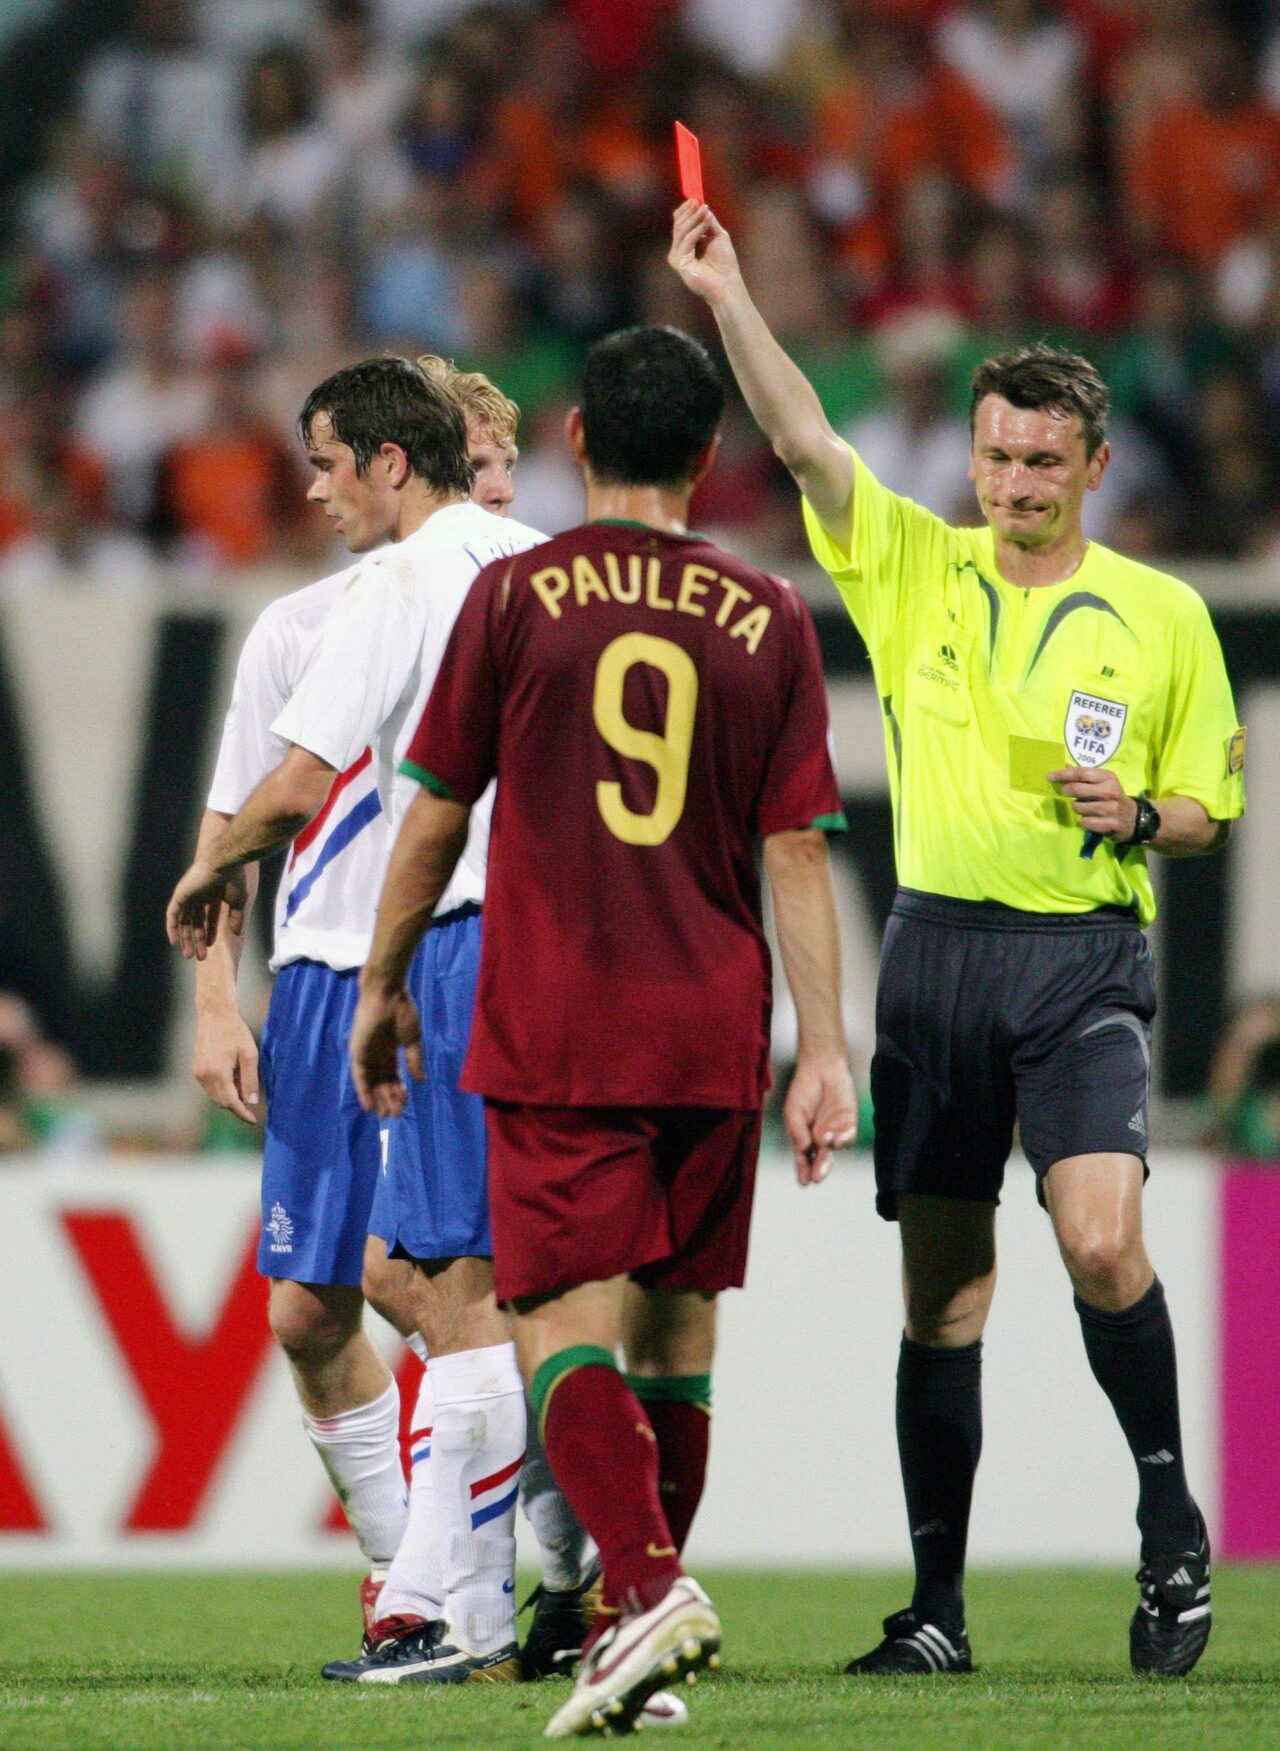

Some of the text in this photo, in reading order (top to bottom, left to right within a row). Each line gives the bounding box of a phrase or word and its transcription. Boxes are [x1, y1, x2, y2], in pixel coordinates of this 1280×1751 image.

[529, 551, 772, 656] PAULETA
[1073, 696, 1124, 719] REFEREE
[592, 631, 699, 847] 9
[1073, 736, 1106, 756] FIFA
[1077, 753, 1097, 765] 2006
[270, 1244, 293, 1253] KNVB
